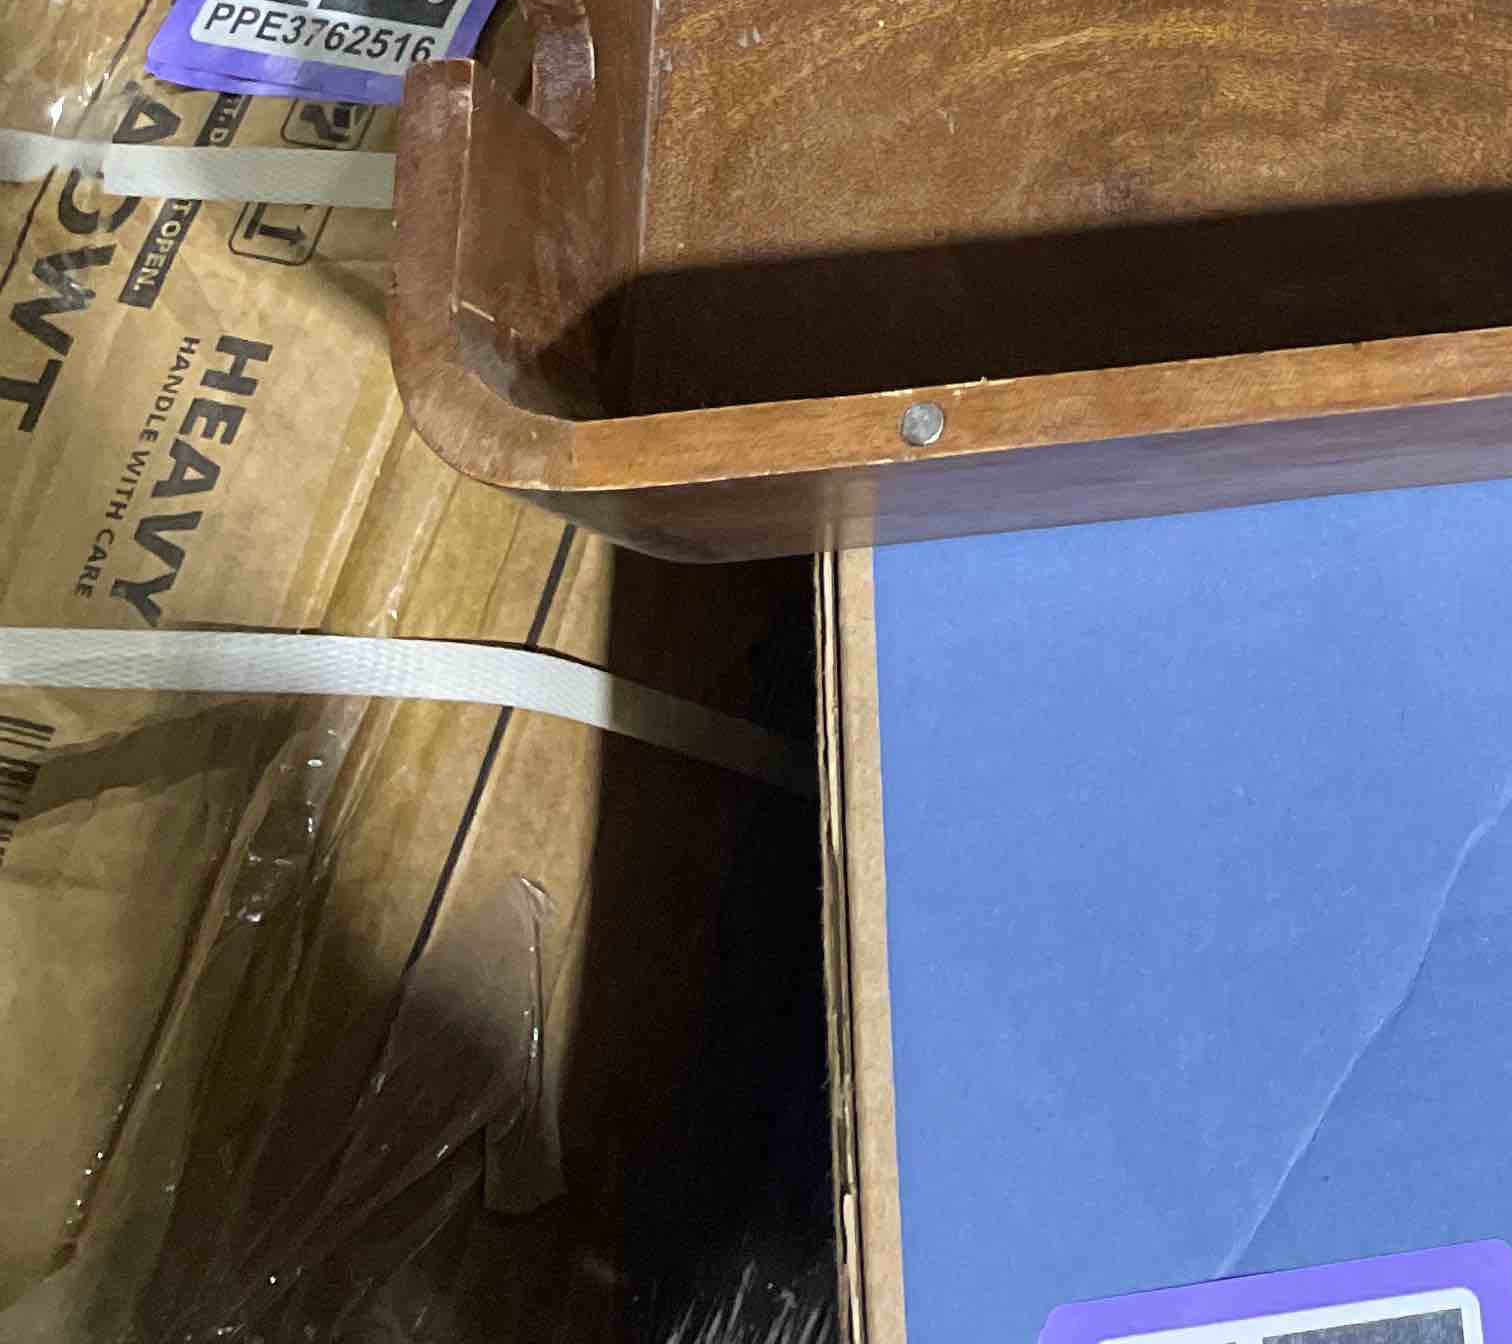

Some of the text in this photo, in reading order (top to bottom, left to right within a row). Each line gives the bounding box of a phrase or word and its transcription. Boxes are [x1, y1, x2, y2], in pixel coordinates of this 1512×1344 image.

[204, 2, 436, 63] PPE3762516
[133, 220, 181, 292] OPEN.
[74, 336, 200, 600] HANDLE WITH CARE
[110, 335, 273, 627] HEAVY
